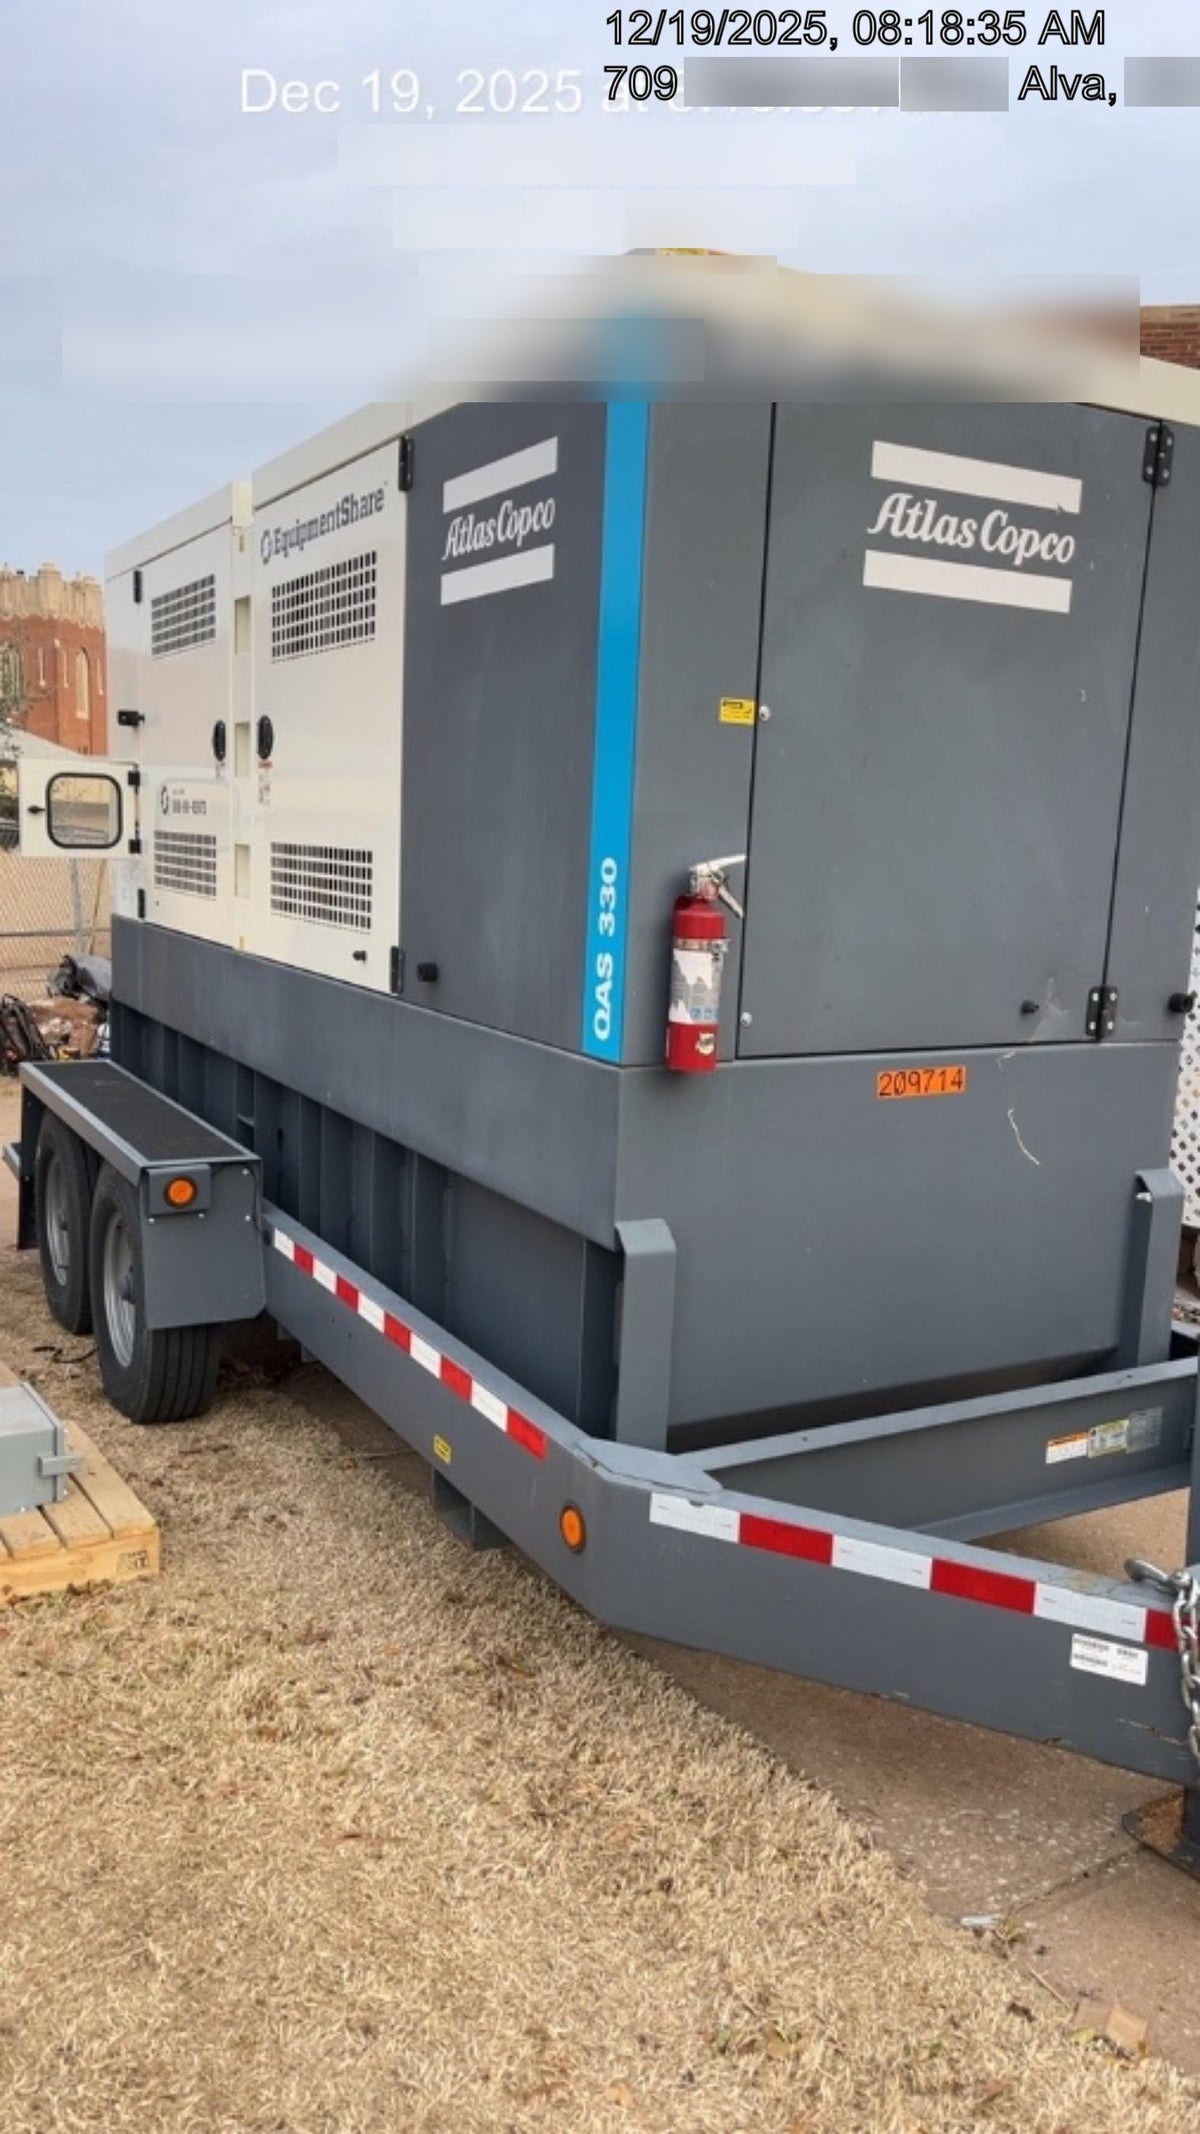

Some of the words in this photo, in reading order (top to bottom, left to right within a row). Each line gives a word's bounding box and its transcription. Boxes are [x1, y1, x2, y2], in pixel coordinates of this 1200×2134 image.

[273, 487, 385, 558] EquipmentShare
[598, 857, 618, 938] 330
[879, 1066, 964, 1097] 209714
